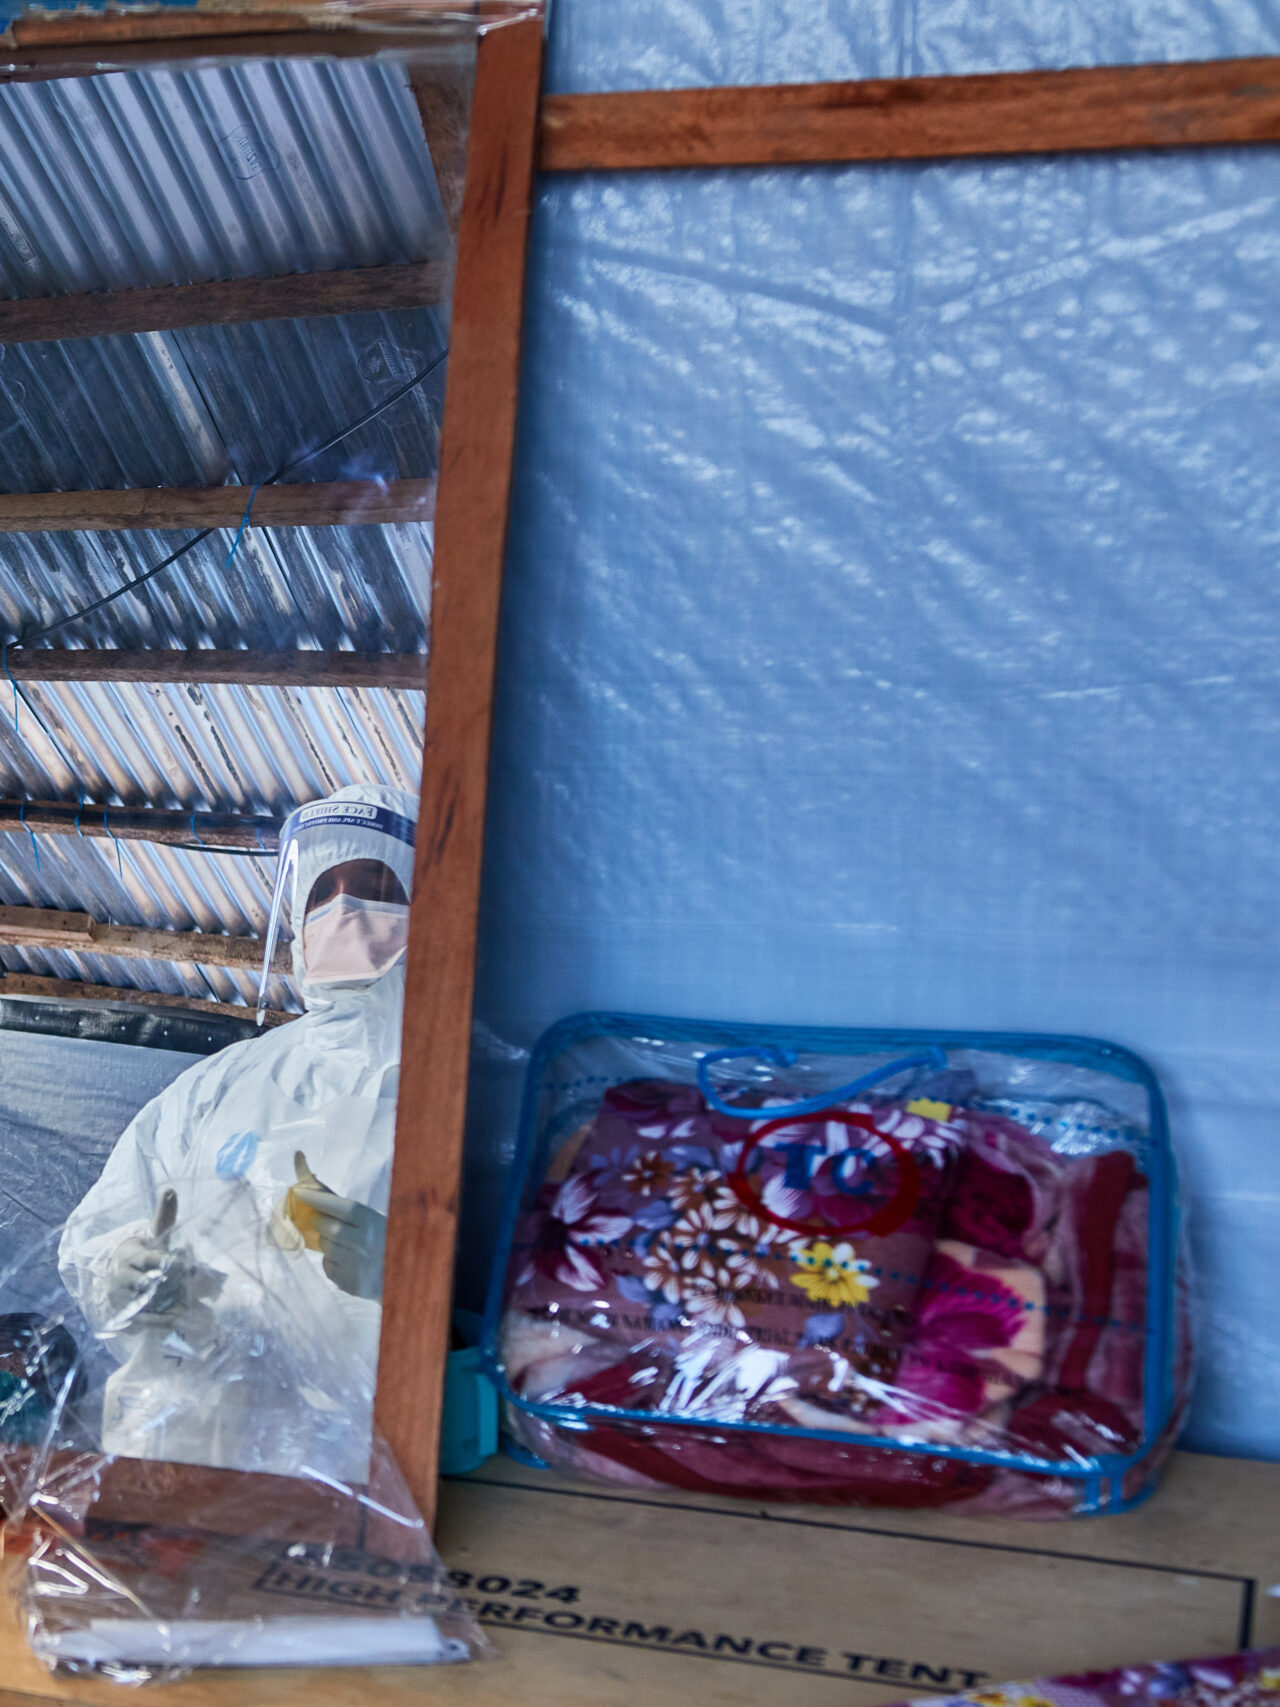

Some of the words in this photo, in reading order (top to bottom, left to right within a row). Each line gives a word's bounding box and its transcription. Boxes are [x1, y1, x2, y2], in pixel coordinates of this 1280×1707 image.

[774, 1142, 877, 1195] TC
[274, 1569, 404, 1604] HIGH
[418, 1592, 828, 1668] PERFORMANCE
[842, 1651, 992, 1688] TENT
